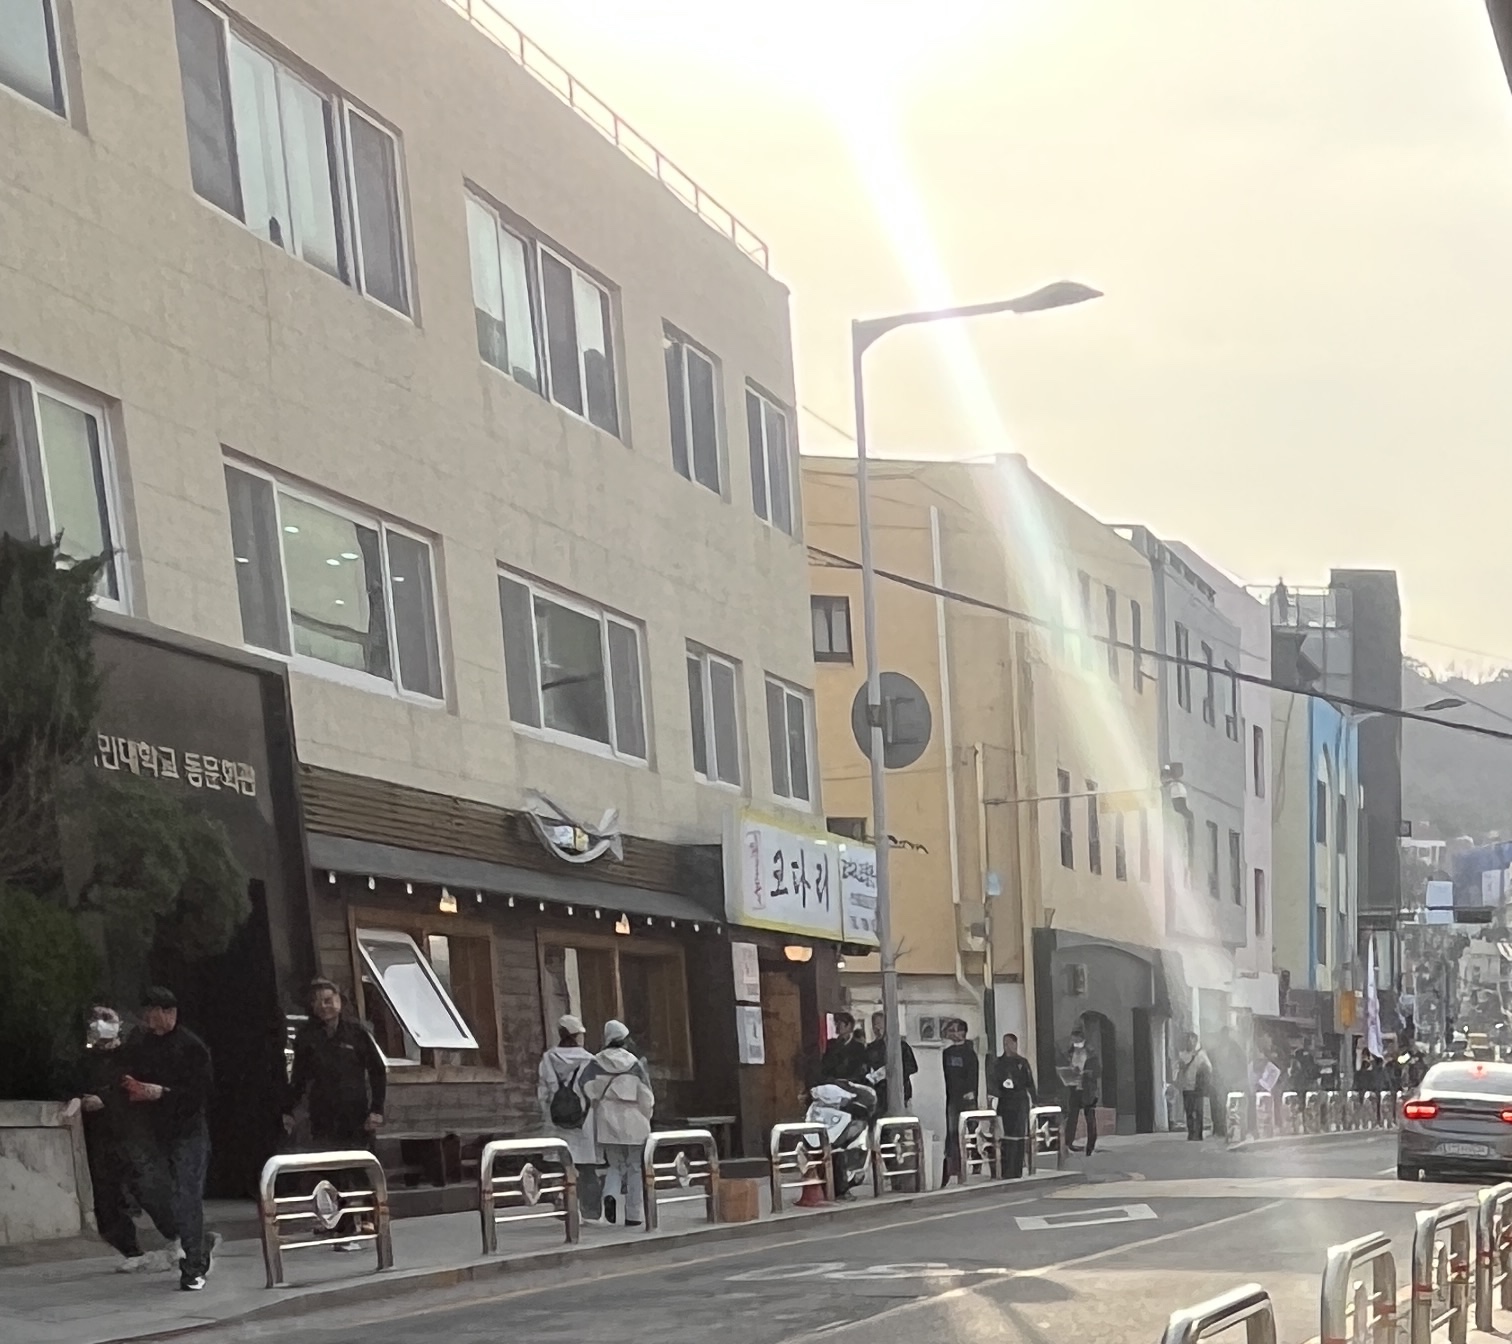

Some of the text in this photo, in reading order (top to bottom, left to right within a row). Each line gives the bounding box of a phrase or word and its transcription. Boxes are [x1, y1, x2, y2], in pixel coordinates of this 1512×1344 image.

[94, 735, 256, 796] 민대학교 동문회관
[770, 848, 830, 912] 코다리
